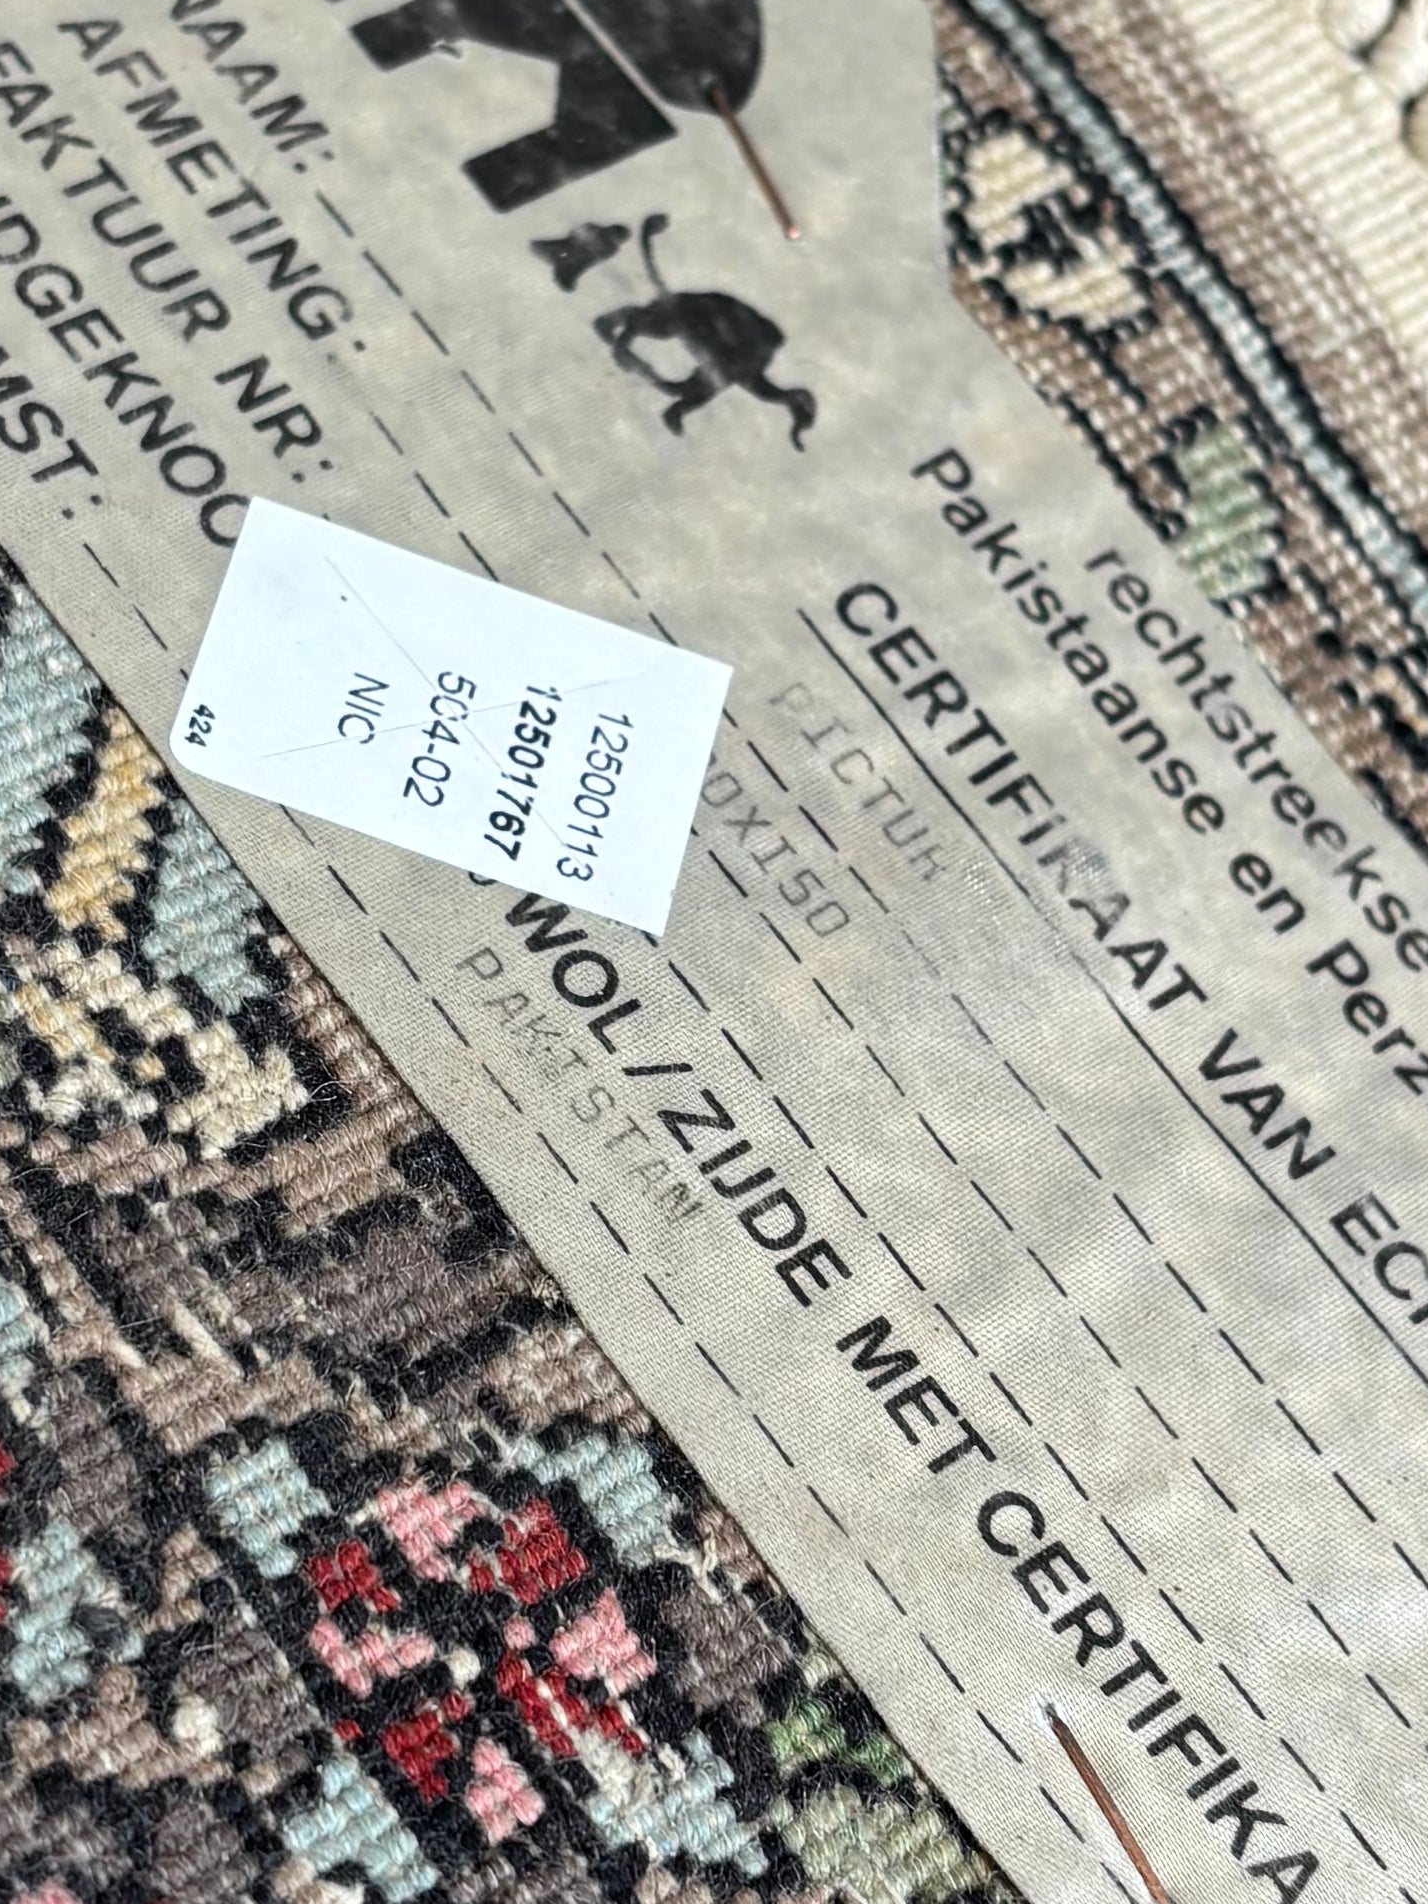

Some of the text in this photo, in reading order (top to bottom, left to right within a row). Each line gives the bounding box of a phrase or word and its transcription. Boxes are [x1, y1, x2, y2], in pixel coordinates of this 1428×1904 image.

[56, 18, 365, 361] AFMETING:
[213, 355, 332, 483] NR:
[183, 703, 217, 748] 424
[336, 671, 390, 745] NIC
[401, 670, 477, 807] 504-02
[483, 685, 561, 861] 12501767
[911, 447, 1225, 834] Pakistaanse
[1229, 852, 1306, 933] en
[557, 713, 632, 881] 12500113
[834, 582, 1208, 1011] CERTIFIKAAT
[1198, 1027, 1336, 1180] VAN
[454, 945, 704, 1227] PAKISTAN
[834, 1315, 997, 1475] MET
